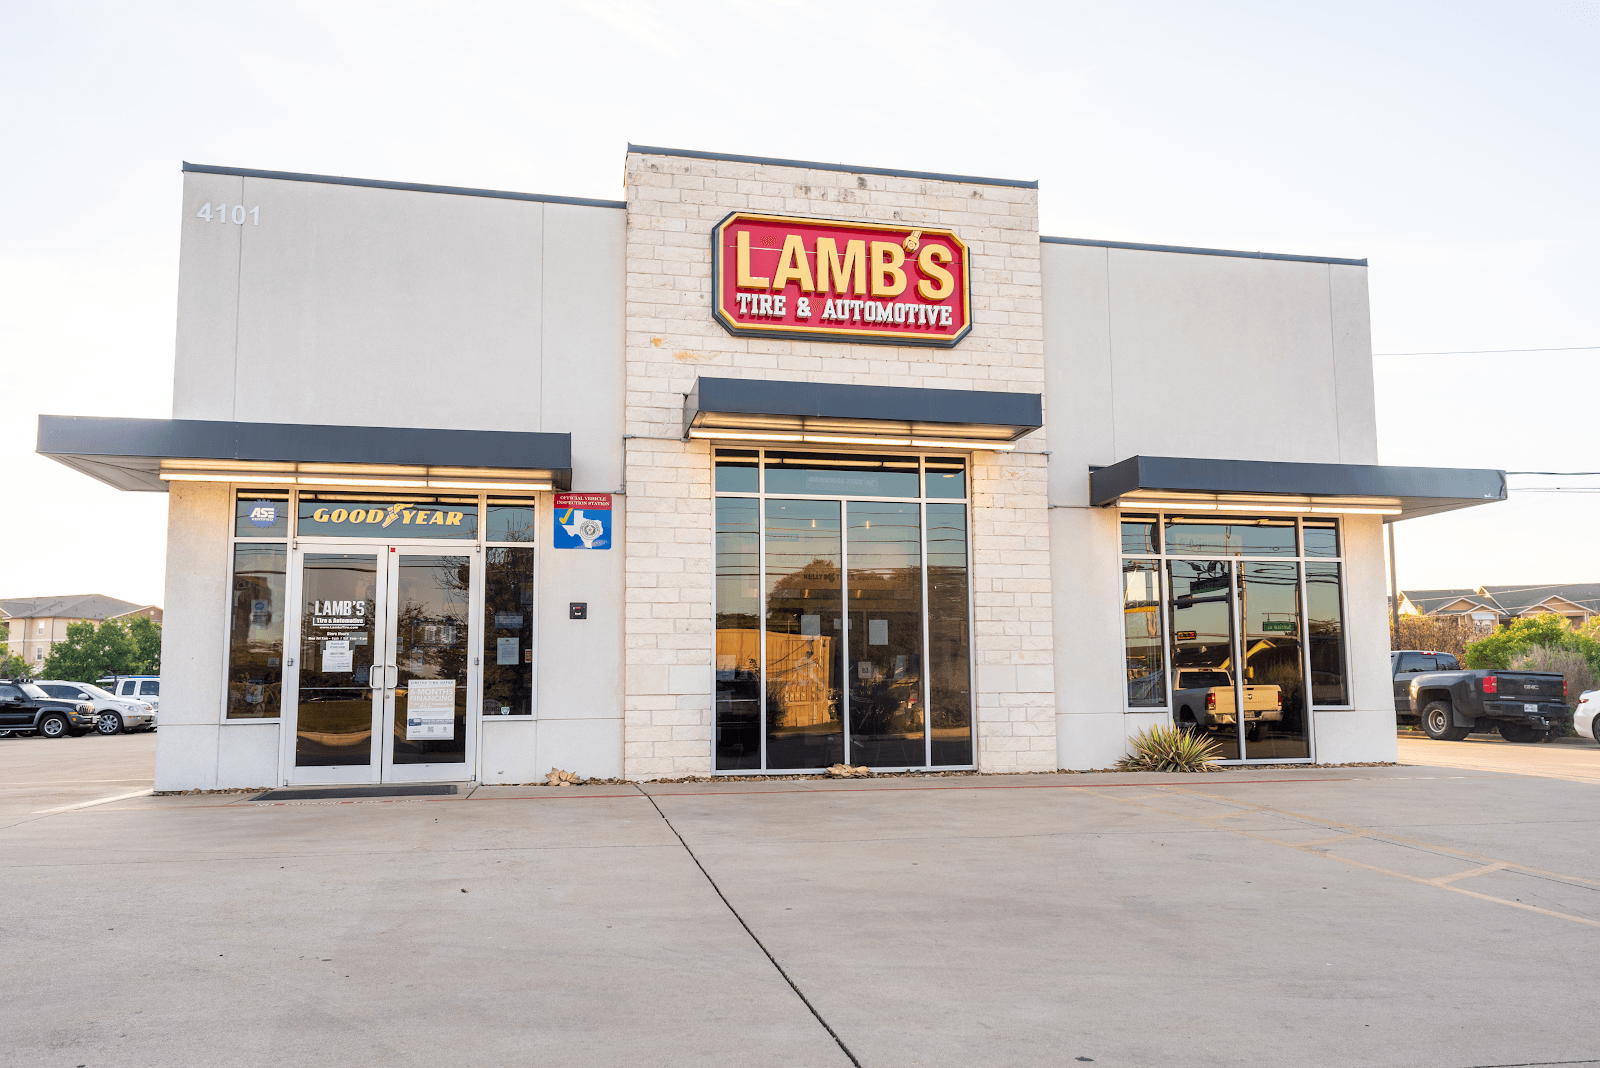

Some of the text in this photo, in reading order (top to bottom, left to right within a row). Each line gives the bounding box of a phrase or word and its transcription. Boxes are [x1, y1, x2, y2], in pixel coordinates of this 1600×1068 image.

[197, 202, 260, 226] 4101
[736, 230, 955, 301] LAMB'S
[736, 292, 953, 327] TIRE & AUTOMOTIVE
[249, 507, 275, 518] ASE
[314, 600, 365, 616] LAMB'S
[409, 688, 454, 696] 6-MONTHS
